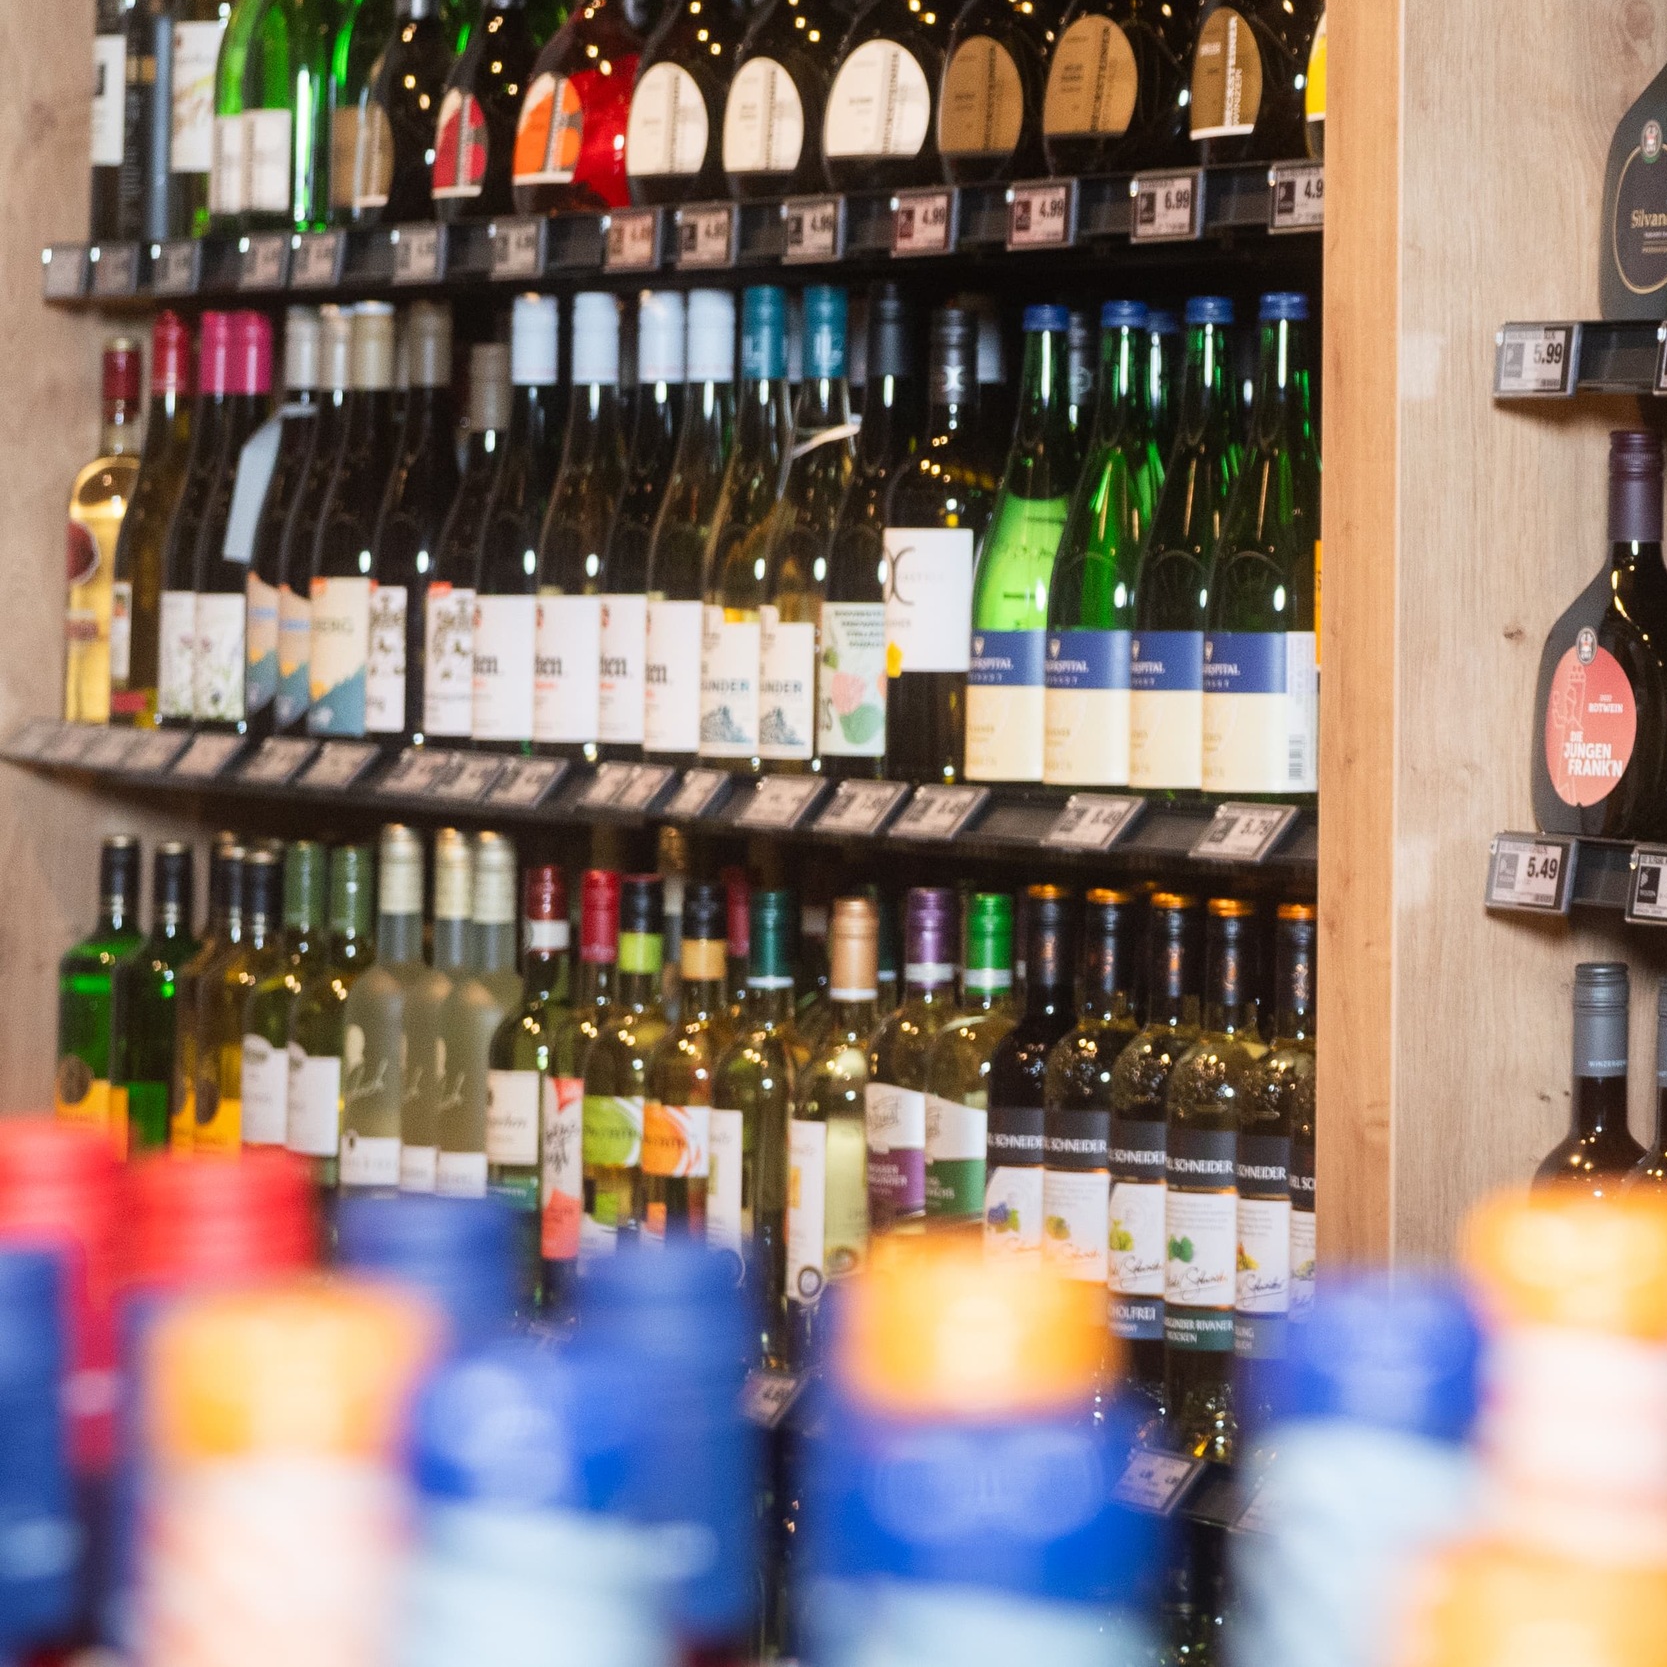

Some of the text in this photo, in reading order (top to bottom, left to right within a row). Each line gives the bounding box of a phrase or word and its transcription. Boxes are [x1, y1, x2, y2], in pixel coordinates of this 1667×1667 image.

[1164, 190, 1191, 210] 6.99
[1533, 342, 1563, 364] 5.99
[1588, 703, 1623, 714] ROTWEIN
[1570, 731, 1583, 742] DIE
[1564, 742, 1612, 759] JUNGEN
[1526, 856, 1558, 881] 5.49
[1173, 1159, 1234, 1175] SCHNEIDER
